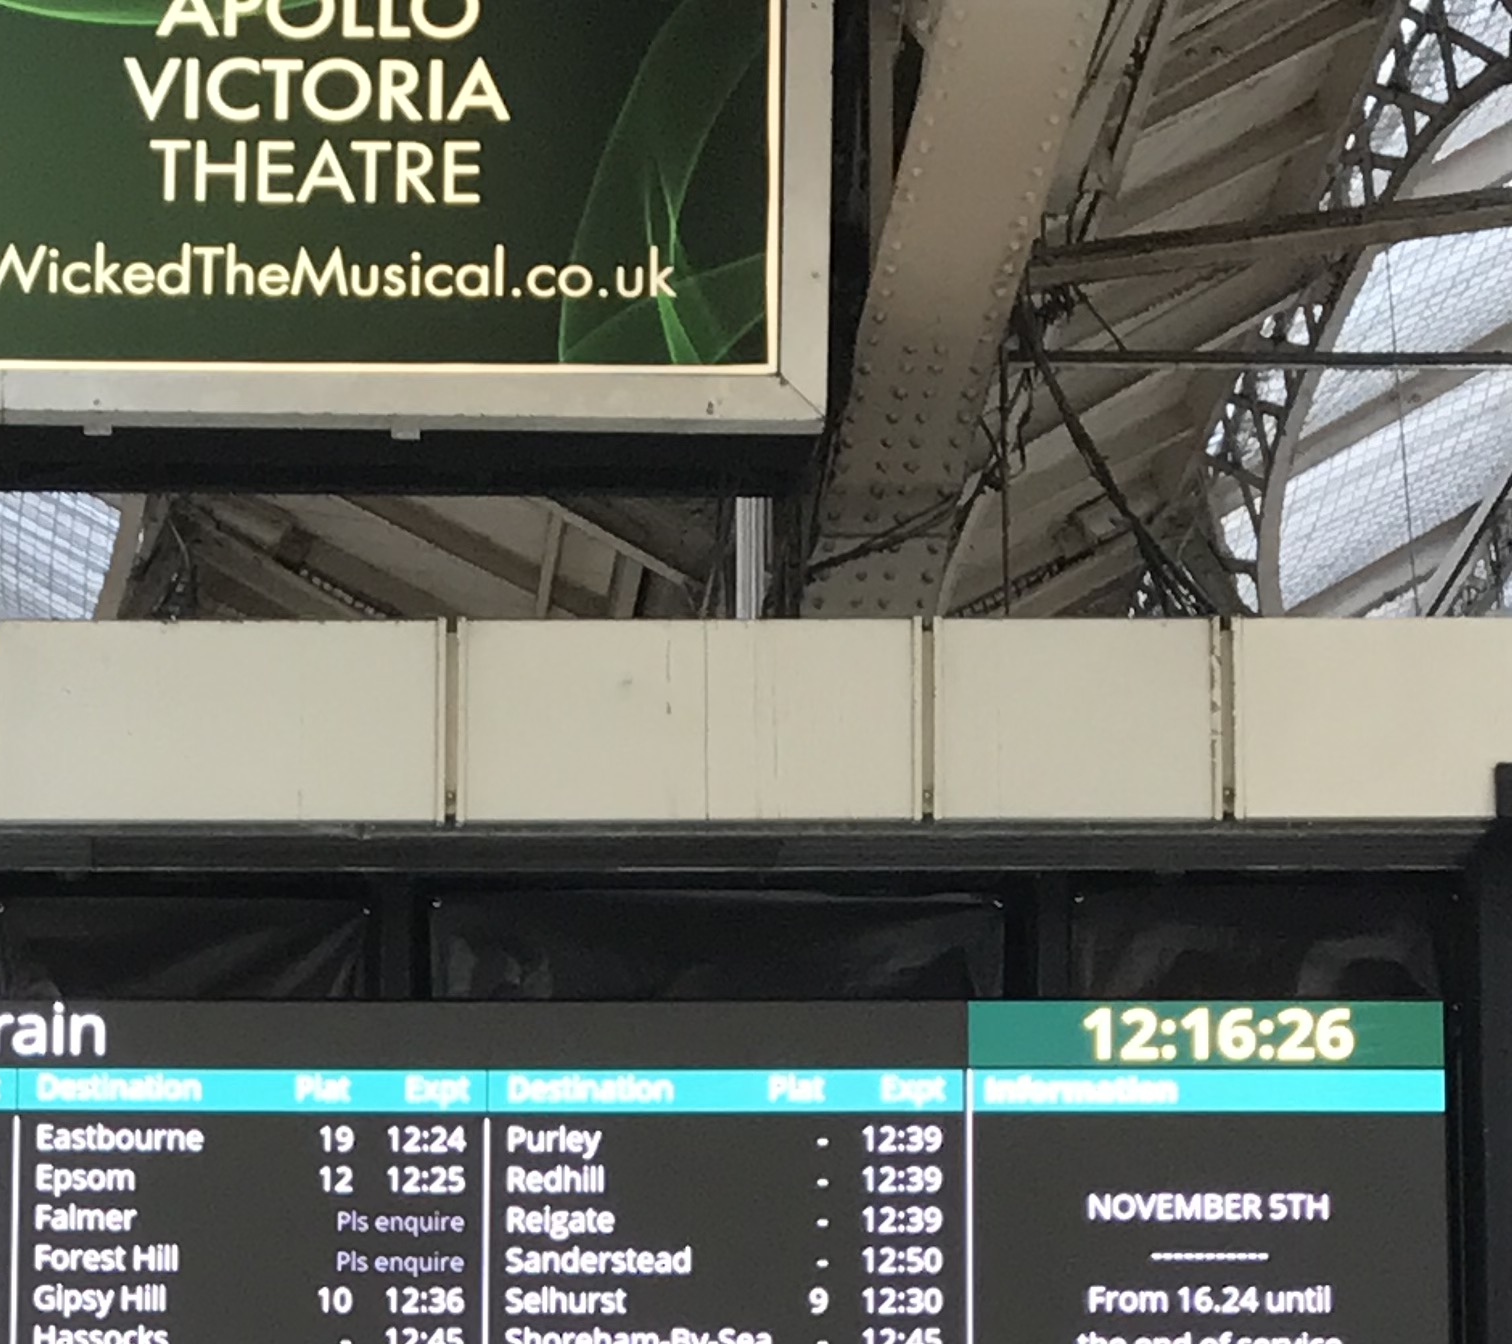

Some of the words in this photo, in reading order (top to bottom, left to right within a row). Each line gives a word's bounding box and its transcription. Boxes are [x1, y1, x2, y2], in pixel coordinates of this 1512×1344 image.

[124, 57, 510, 122] VICTORIA
[150, 140, 480, 203] THEATRE
[1084, 1008, 1354, 1061] 12:16:26
[984, 1076, 1179, 1105] Information
[37, 1123, 204, 1152] Eastbourne
[320, 1126, 354, 1152] 19
[388, 1126, 467, 1153] 12:24
[35, 1203, 137, 1231] Falmer
[338, 1211, 368, 1232] Pls
[375, 1212, 464, 1237] enquire
[1088, 1193, 1262, 1221] NOVEMBER
[1269, 1193, 1329, 1220] 5TH
[1088, 1286, 1168, 1313] From
[1178, 1286, 1259, 1314] 16.24
[1265, 1285, 1331, 1313] until
